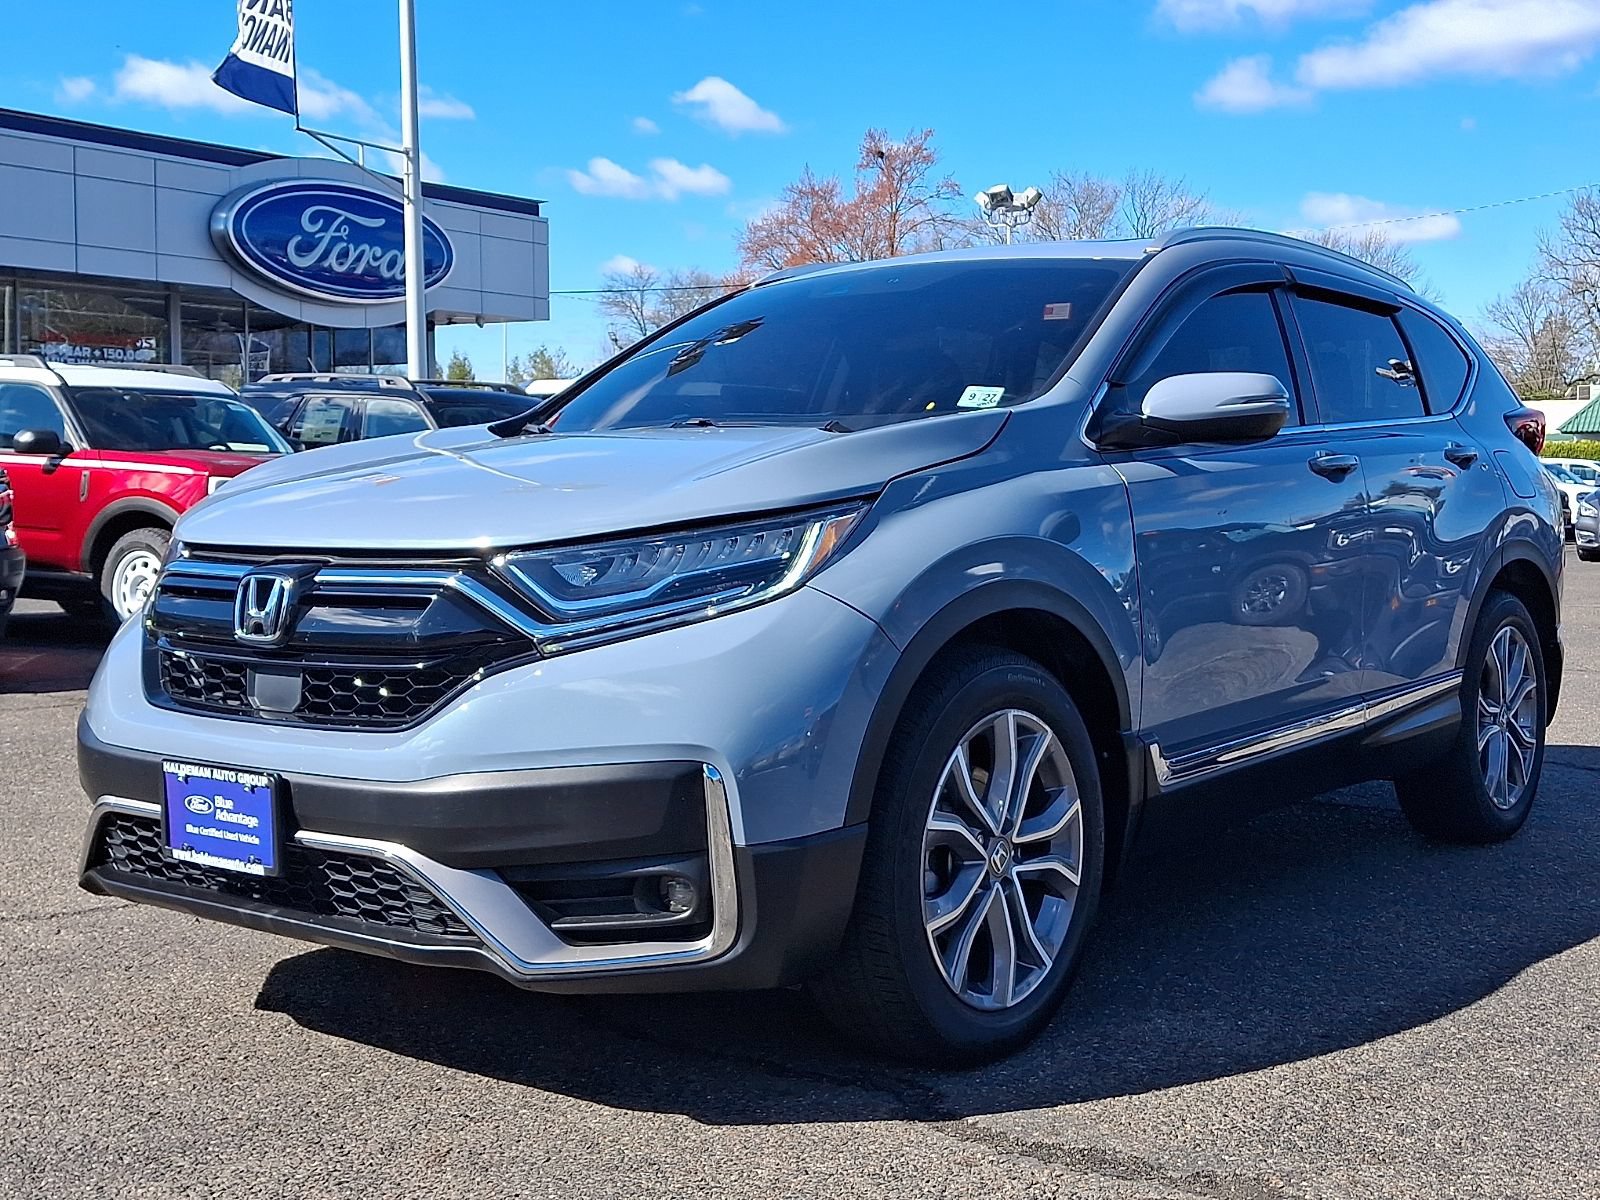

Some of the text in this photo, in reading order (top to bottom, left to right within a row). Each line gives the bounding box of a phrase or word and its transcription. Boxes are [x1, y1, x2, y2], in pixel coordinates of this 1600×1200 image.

[163, 761, 269, 787] HALDEMAN AUTO GROUP
[214, 795, 234, 810] Blue
[215, 808, 259, 829] Advantage
[200, 827, 223, 838] Certified
[224, 831, 239, 841] Used
